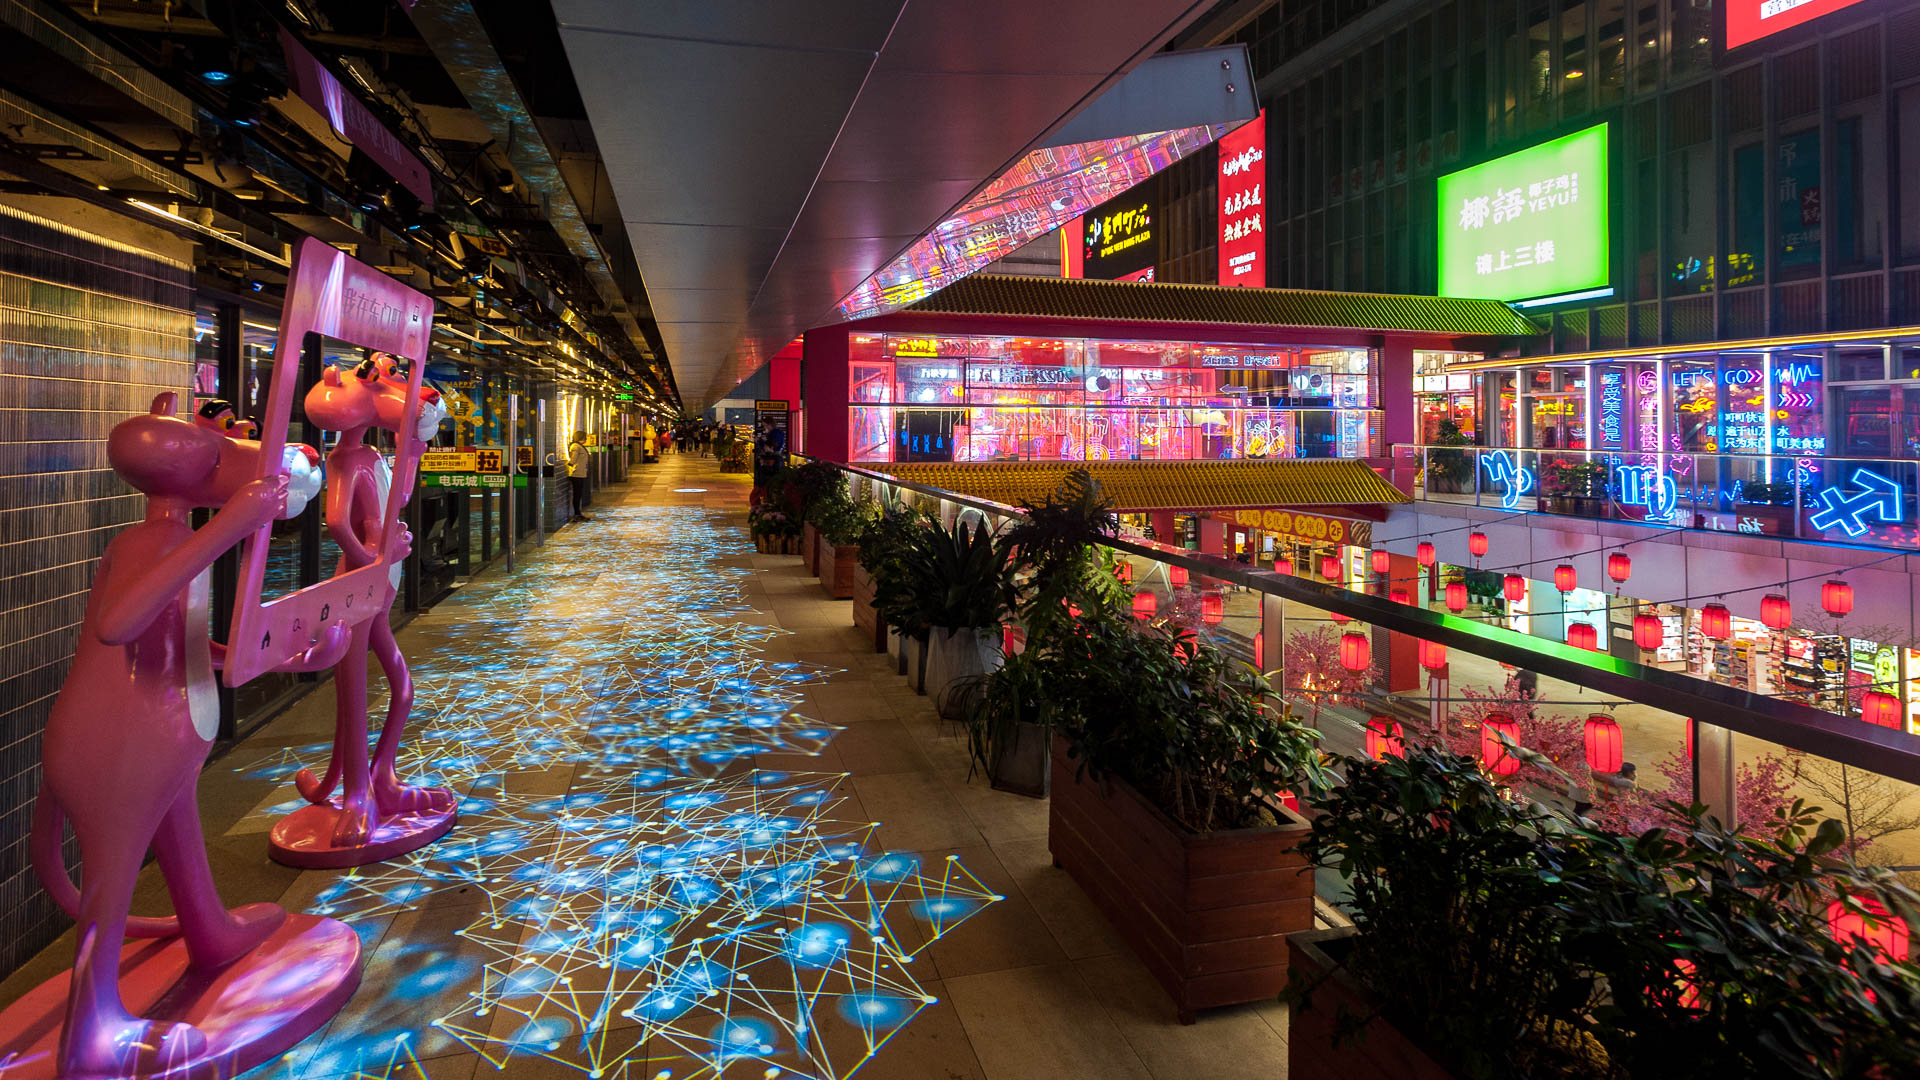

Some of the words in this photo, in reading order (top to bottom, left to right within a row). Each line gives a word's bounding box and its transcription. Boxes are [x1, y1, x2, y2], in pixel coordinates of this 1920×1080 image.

[1528, 191, 1569, 213] YEYU
[1475, 240, 1555, 275] 请上三楼
[1672, 369, 1714, 387] LET'S
[1725, 370, 1749, 384] GO
[478, 451, 499, 471] 拉
[439, 475, 478, 487] 电玩城
[1330, 524, 1341, 537] 2F
